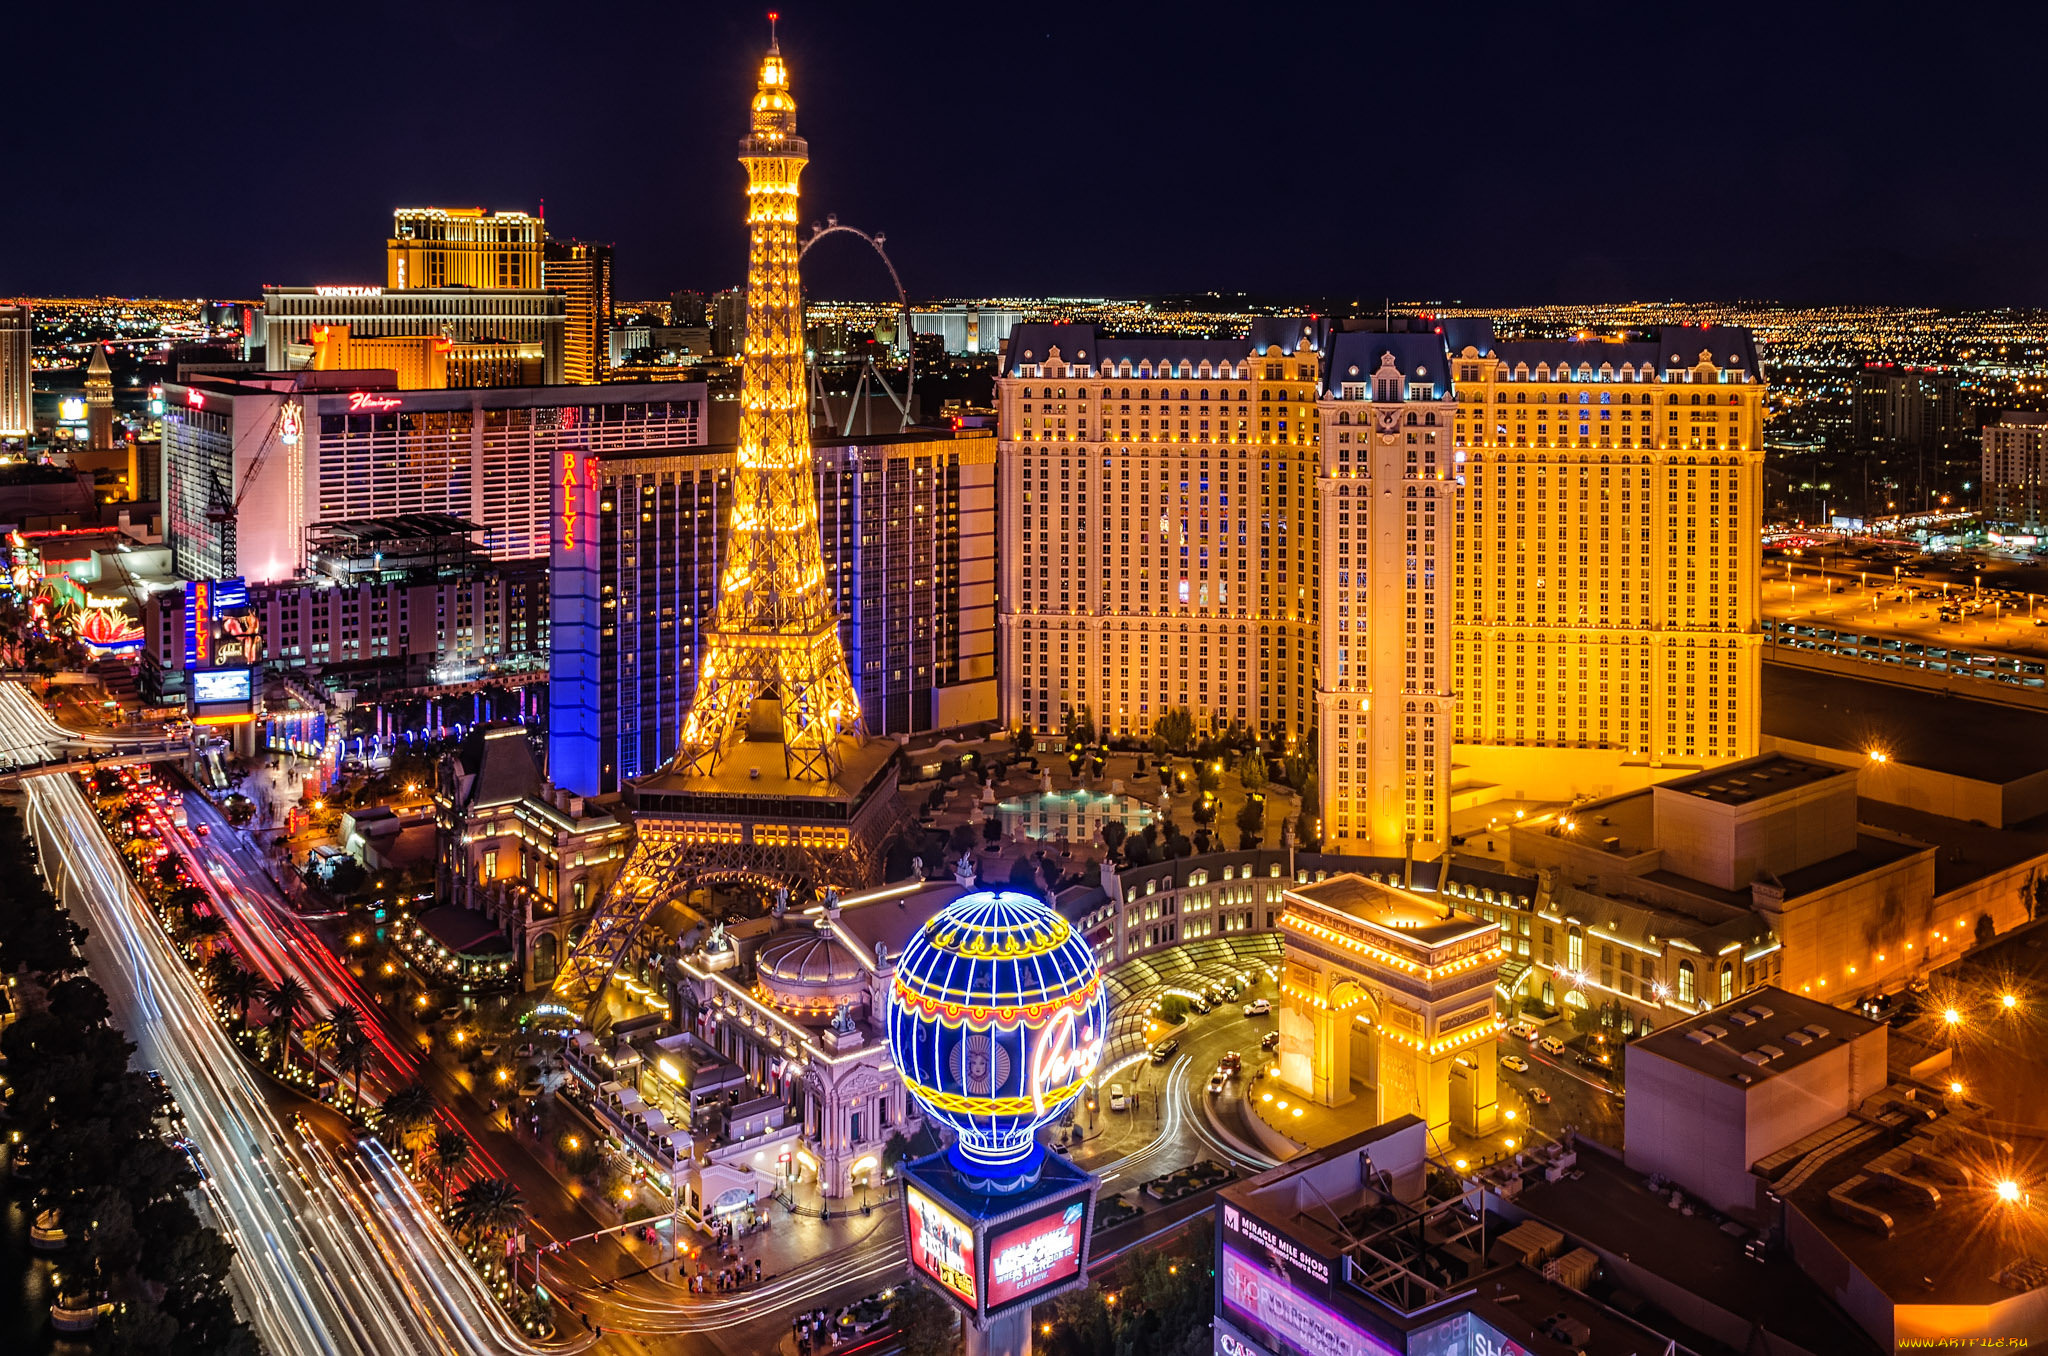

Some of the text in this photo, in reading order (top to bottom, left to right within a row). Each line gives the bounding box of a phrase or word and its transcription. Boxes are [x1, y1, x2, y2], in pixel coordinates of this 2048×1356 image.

[316, 286, 382, 297] VENETIAN
[349, 392, 402, 411] Flamingo
[195, 584, 208, 660] BALLYS
[1033, 1006, 1102, 1116] Paris
[1242, 1216, 1277, 1245] MIRACLE
[1279, 1239, 1298, 1258] MILE
[1300, 1252, 1329, 1276] SHOPS
[1016, 1278, 1032, 1290] PLAY
